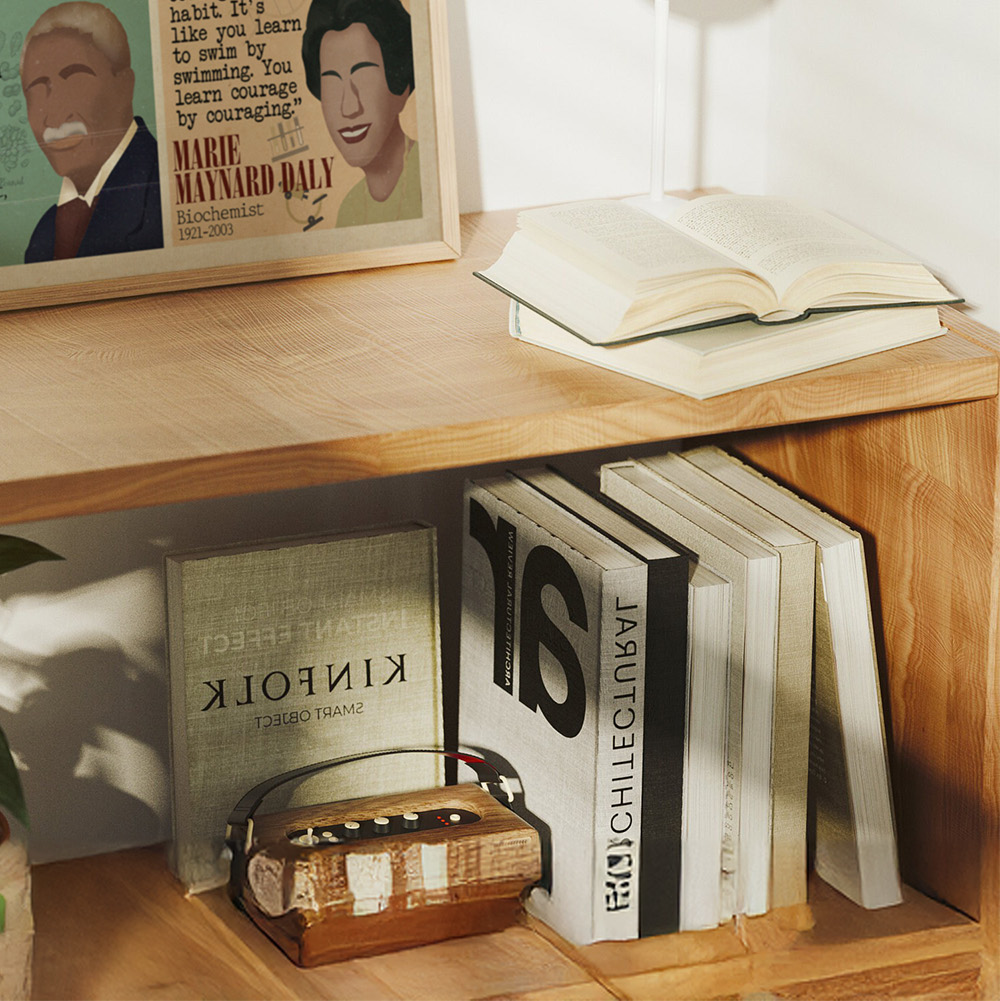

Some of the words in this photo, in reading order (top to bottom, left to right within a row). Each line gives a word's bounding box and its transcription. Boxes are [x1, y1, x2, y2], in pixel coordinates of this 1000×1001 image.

[169, 4, 222, 23] habit.
[230, 0, 265, 18] It’s
[171, 26, 207, 44] like
[216, 23, 246, 45] you
[254, 18, 303, 36] learn
[173, 48, 191, 64] to
[199, 42, 237, 63] swim
[245, 40, 266, 60] by
[173, 65, 254, 85] swimming.
[261, 58, 293, 77] You
[175, 88, 222, 106] learn
[230, 80, 297, 101] courage
[177, 110, 198, 130] by
[206, 97, 303, 123] couraging.”
[172, 133, 241, 172] MARIE
[174, 163, 274, 206] MAYNARD
[280, 156, 335, 194] DALY
[177, 202, 264, 226] Biochemist
[178, 222, 234, 241] 1921-2003
